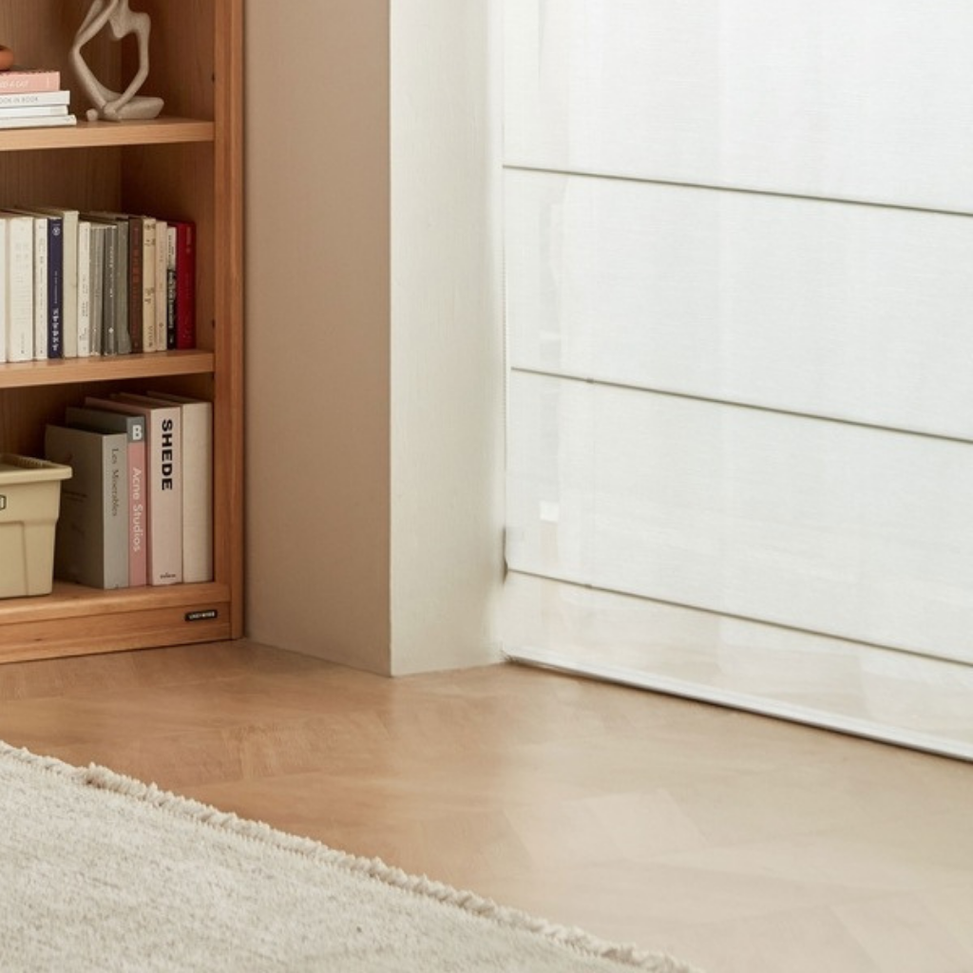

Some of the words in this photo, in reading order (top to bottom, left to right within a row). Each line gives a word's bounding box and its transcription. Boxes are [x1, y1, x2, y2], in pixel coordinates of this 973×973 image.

[132, 425, 142, 440] B
[161, 419, 173, 491] SHEDE
[132, 467, 142, 500] Acne
[132, 504, 144, 553] Studios
